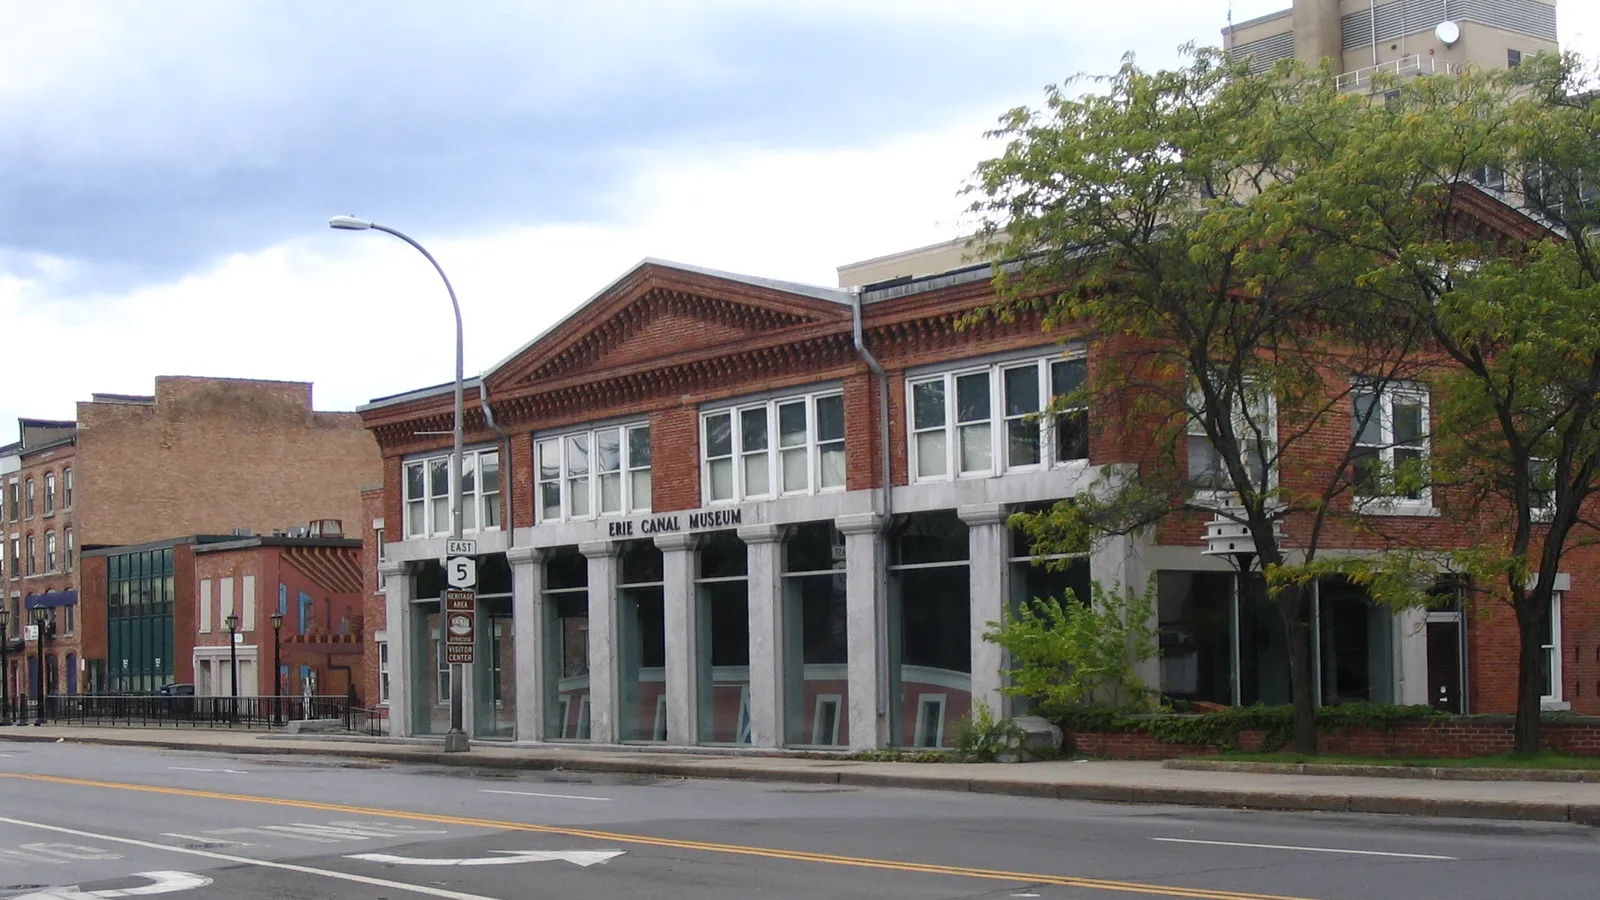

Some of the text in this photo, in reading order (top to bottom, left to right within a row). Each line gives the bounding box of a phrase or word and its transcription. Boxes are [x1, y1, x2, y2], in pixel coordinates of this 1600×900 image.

[608, 508, 742, 537] ERIE CANAL MUSEUM
[451, 542, 472, 552] EAST
[457, 564, 467, 581] 5
